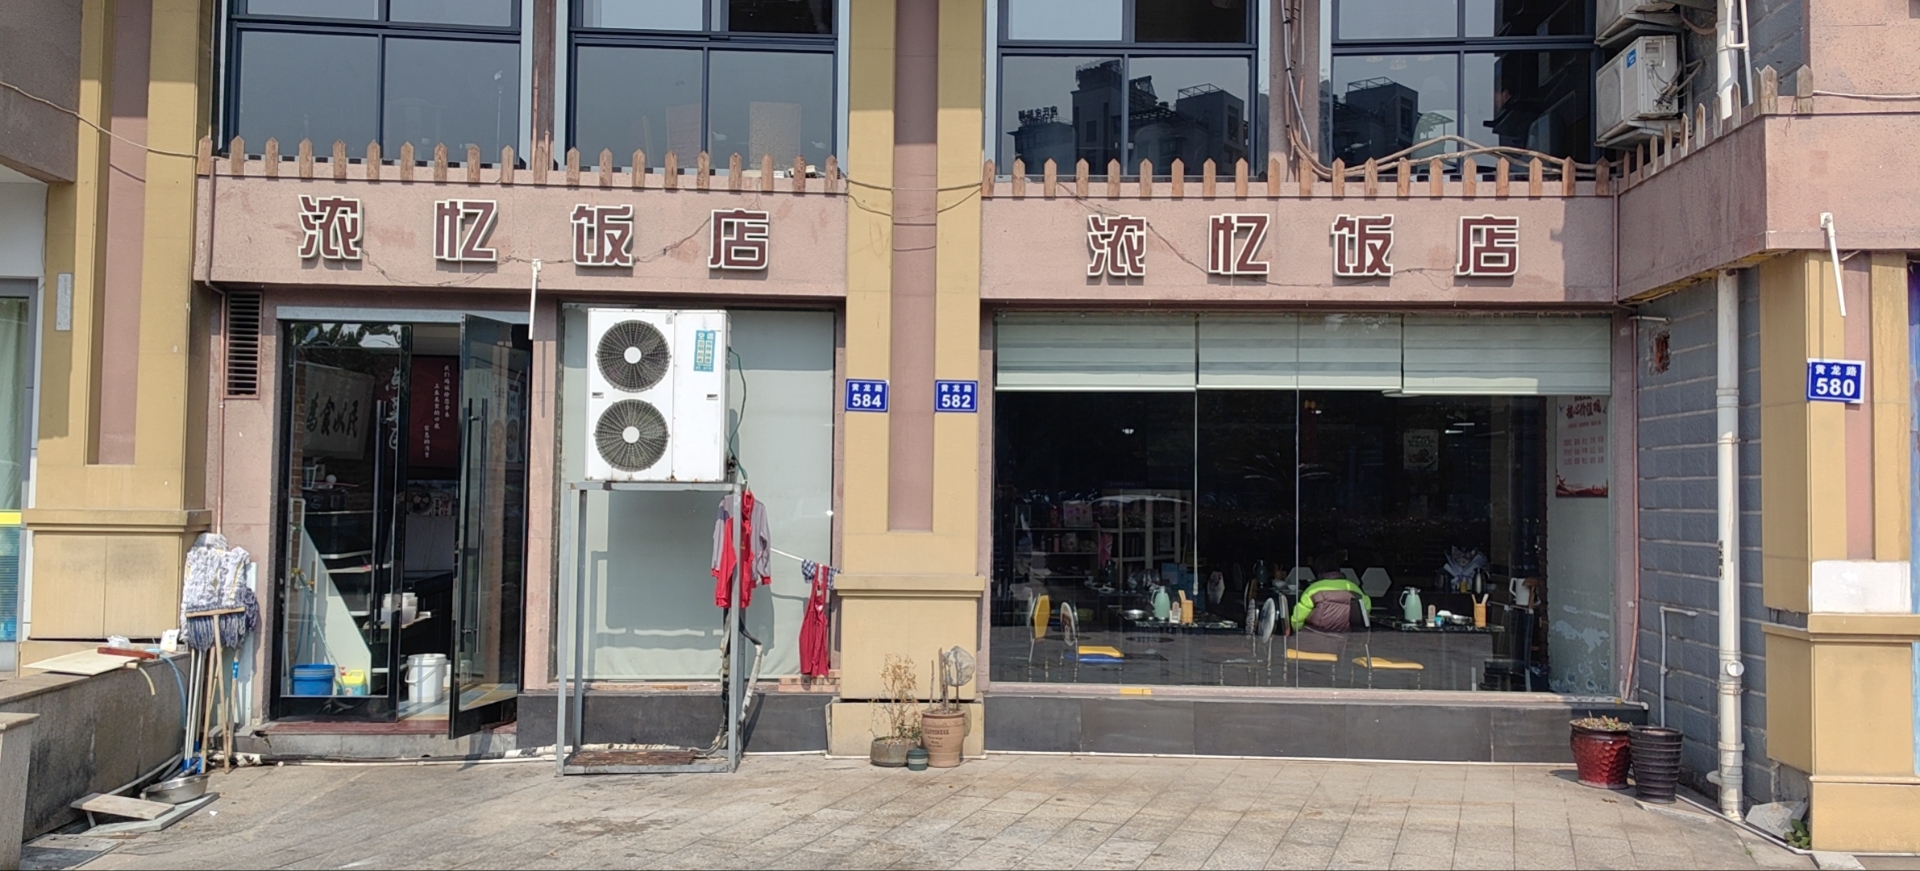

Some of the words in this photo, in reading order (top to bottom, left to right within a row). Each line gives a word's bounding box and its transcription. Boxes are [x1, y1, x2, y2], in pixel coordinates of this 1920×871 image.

[298, 195, 769, 269] 浓忆饭店
[1088, 213, 1519, 276] 浓忆饭店
[1815, 364, 1857, 377] 黄龙路
[851, 383, 883, 393] 黄龙路
[941, 384, 972, 393] 黄龙路
[1815, 377, 1855, 397] 580
[852, 394, 882, 408] 584
[941, 394, 971, 408] 582
